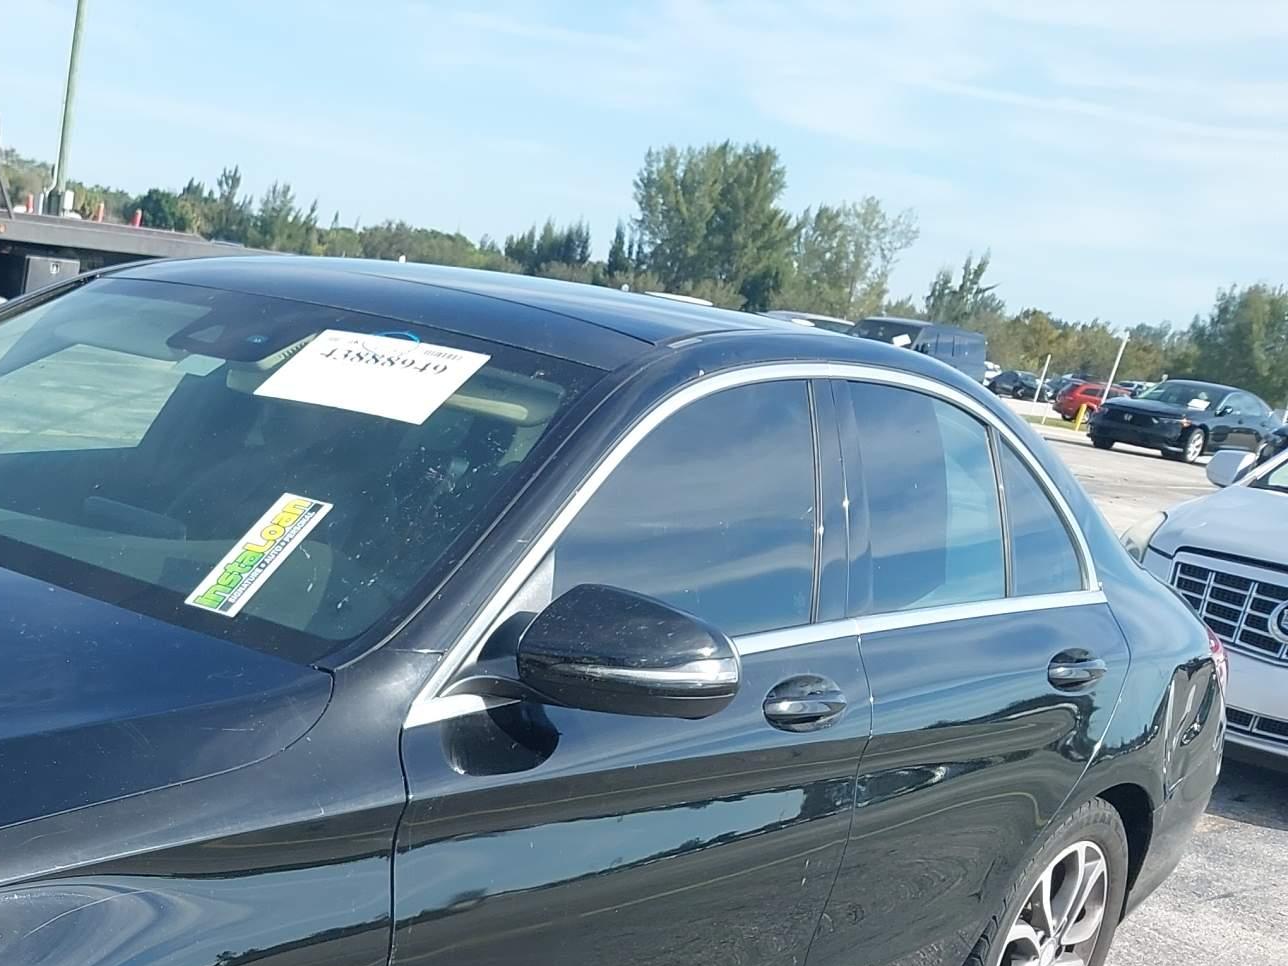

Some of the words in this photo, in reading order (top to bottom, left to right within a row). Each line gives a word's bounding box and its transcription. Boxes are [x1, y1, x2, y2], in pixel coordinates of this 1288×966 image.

[228, 568, 262, 603] SIGNATURE
[265, 545, 283, 563] AUTO
[286, 511, 315, 543] PERSONAL
